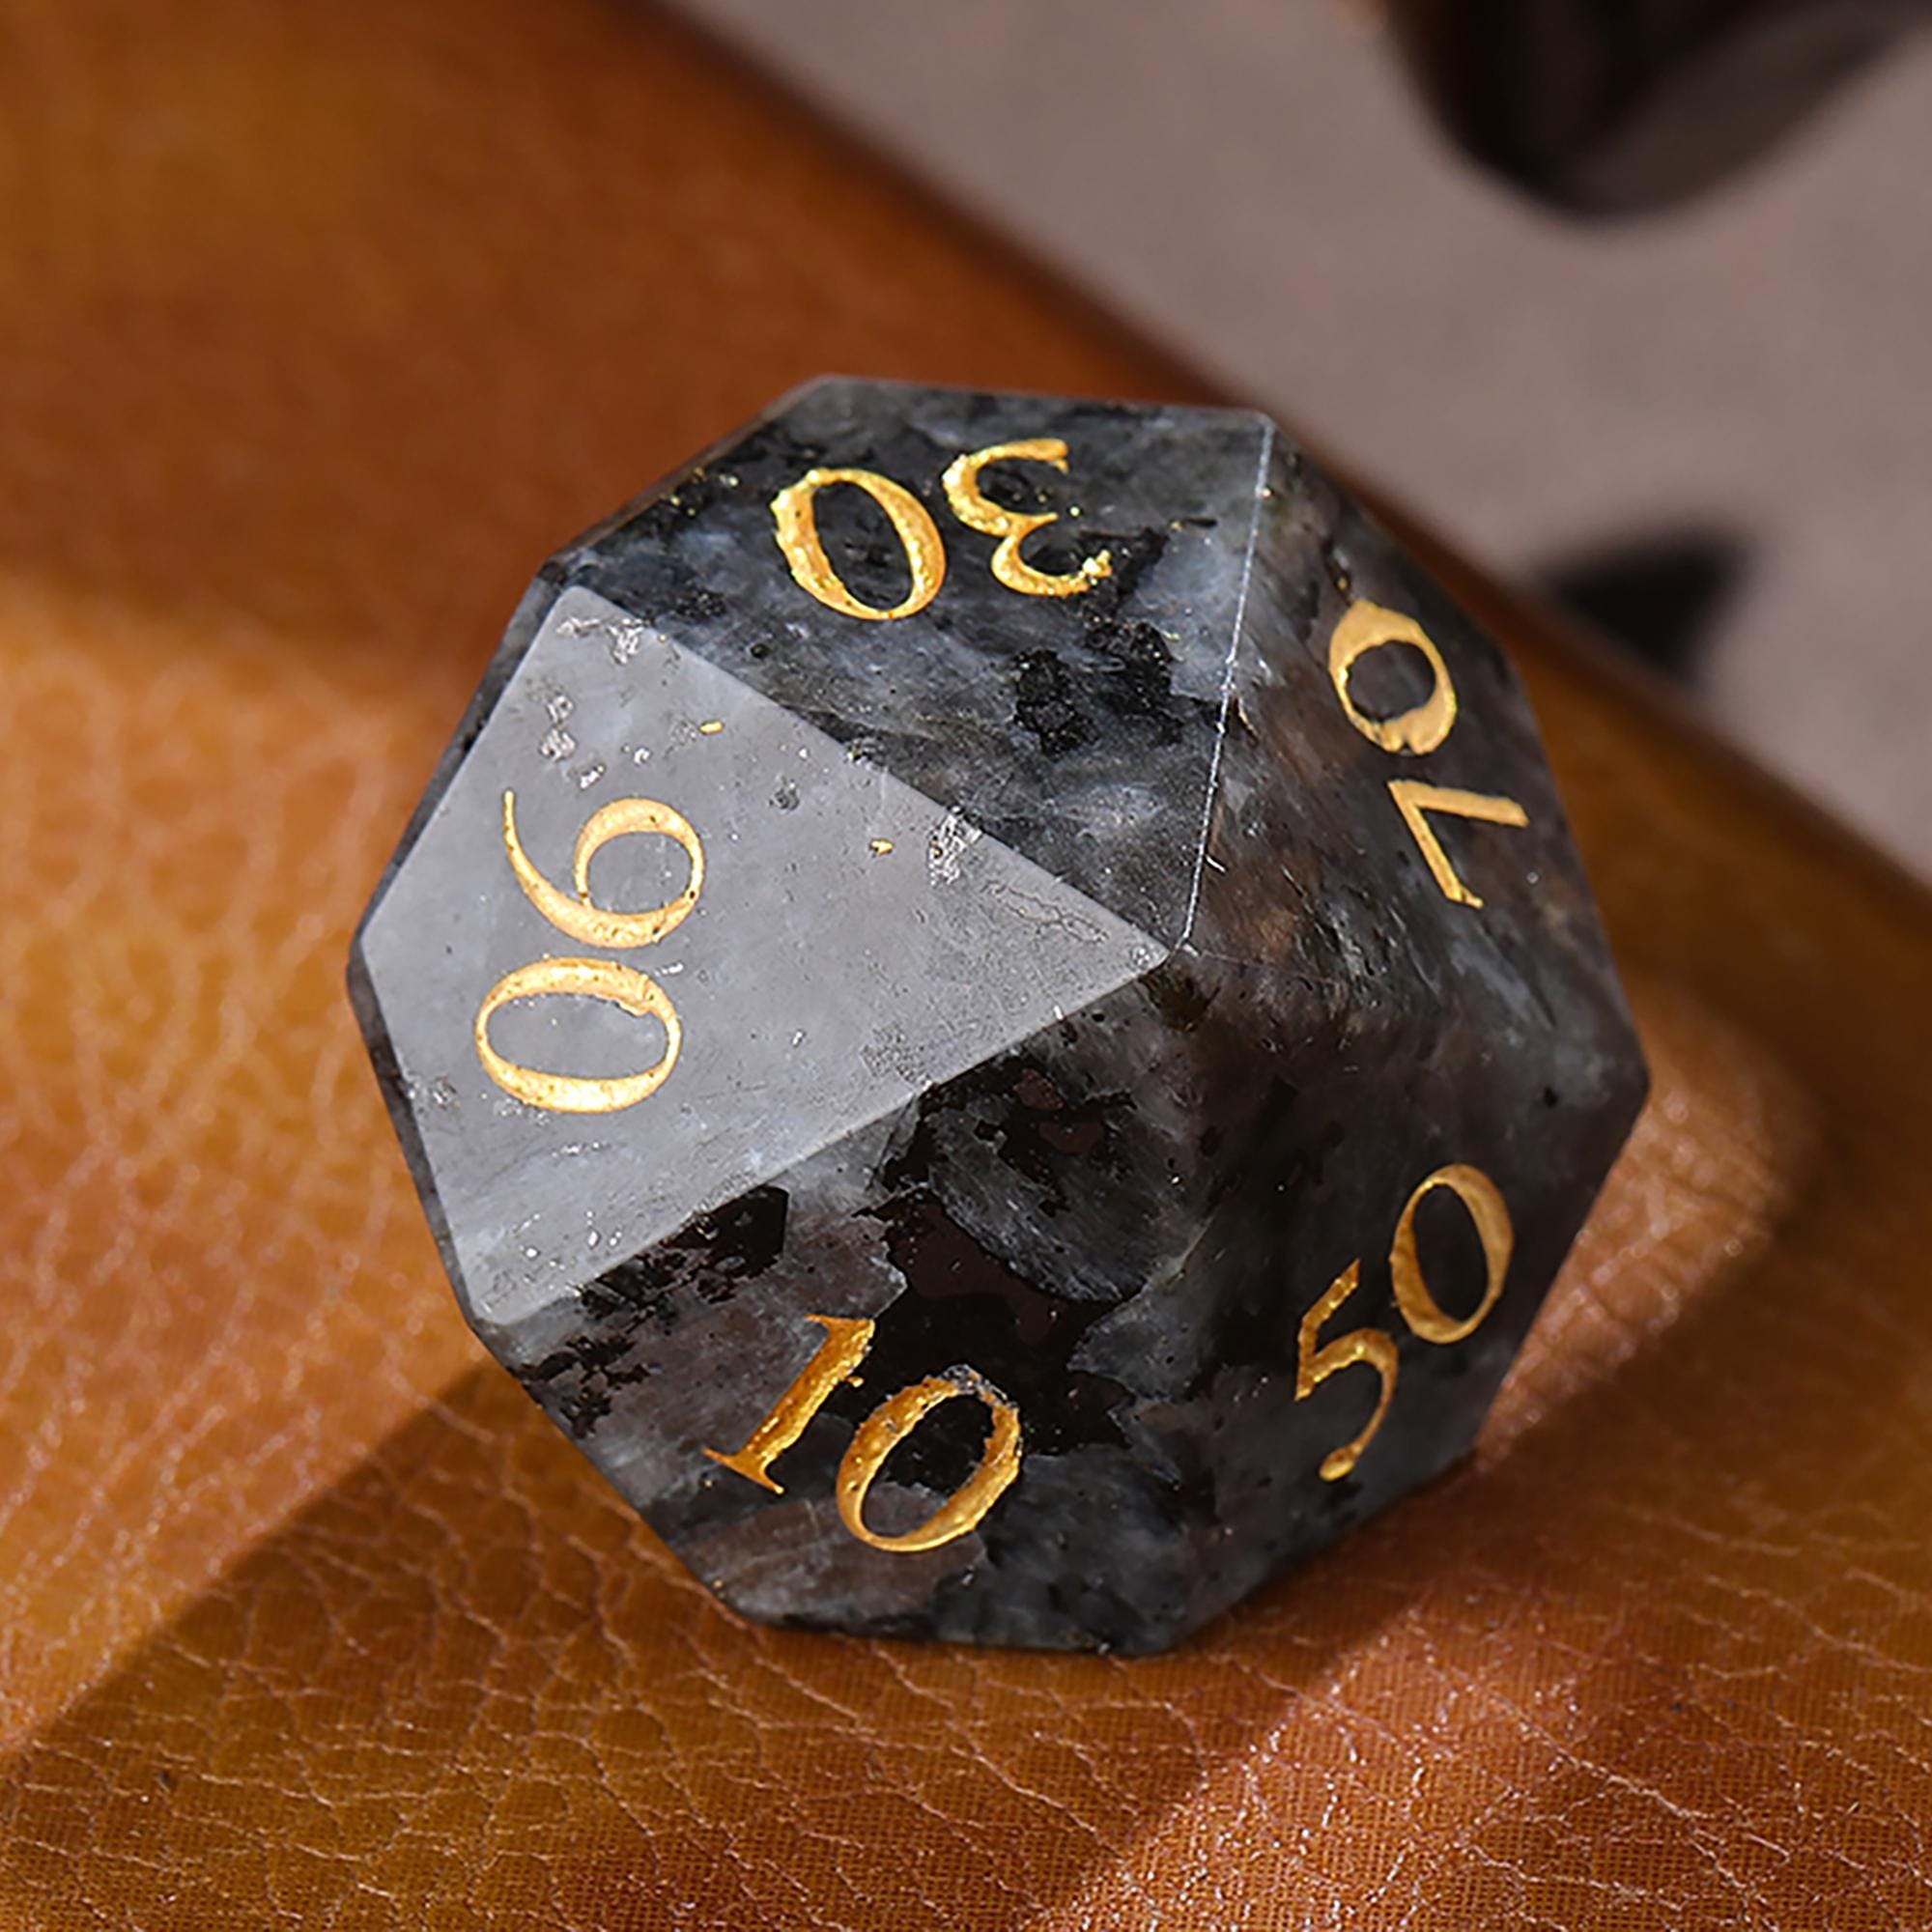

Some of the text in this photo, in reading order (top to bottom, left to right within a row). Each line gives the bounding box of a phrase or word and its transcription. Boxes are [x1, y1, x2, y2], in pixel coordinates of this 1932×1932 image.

[772, 438, 1114, 621] 30
[1328, 598, 1529, 910] 70
[702, 1313, 1022, 1553] 10
[1293, 1163, 1514, 1483] 50
